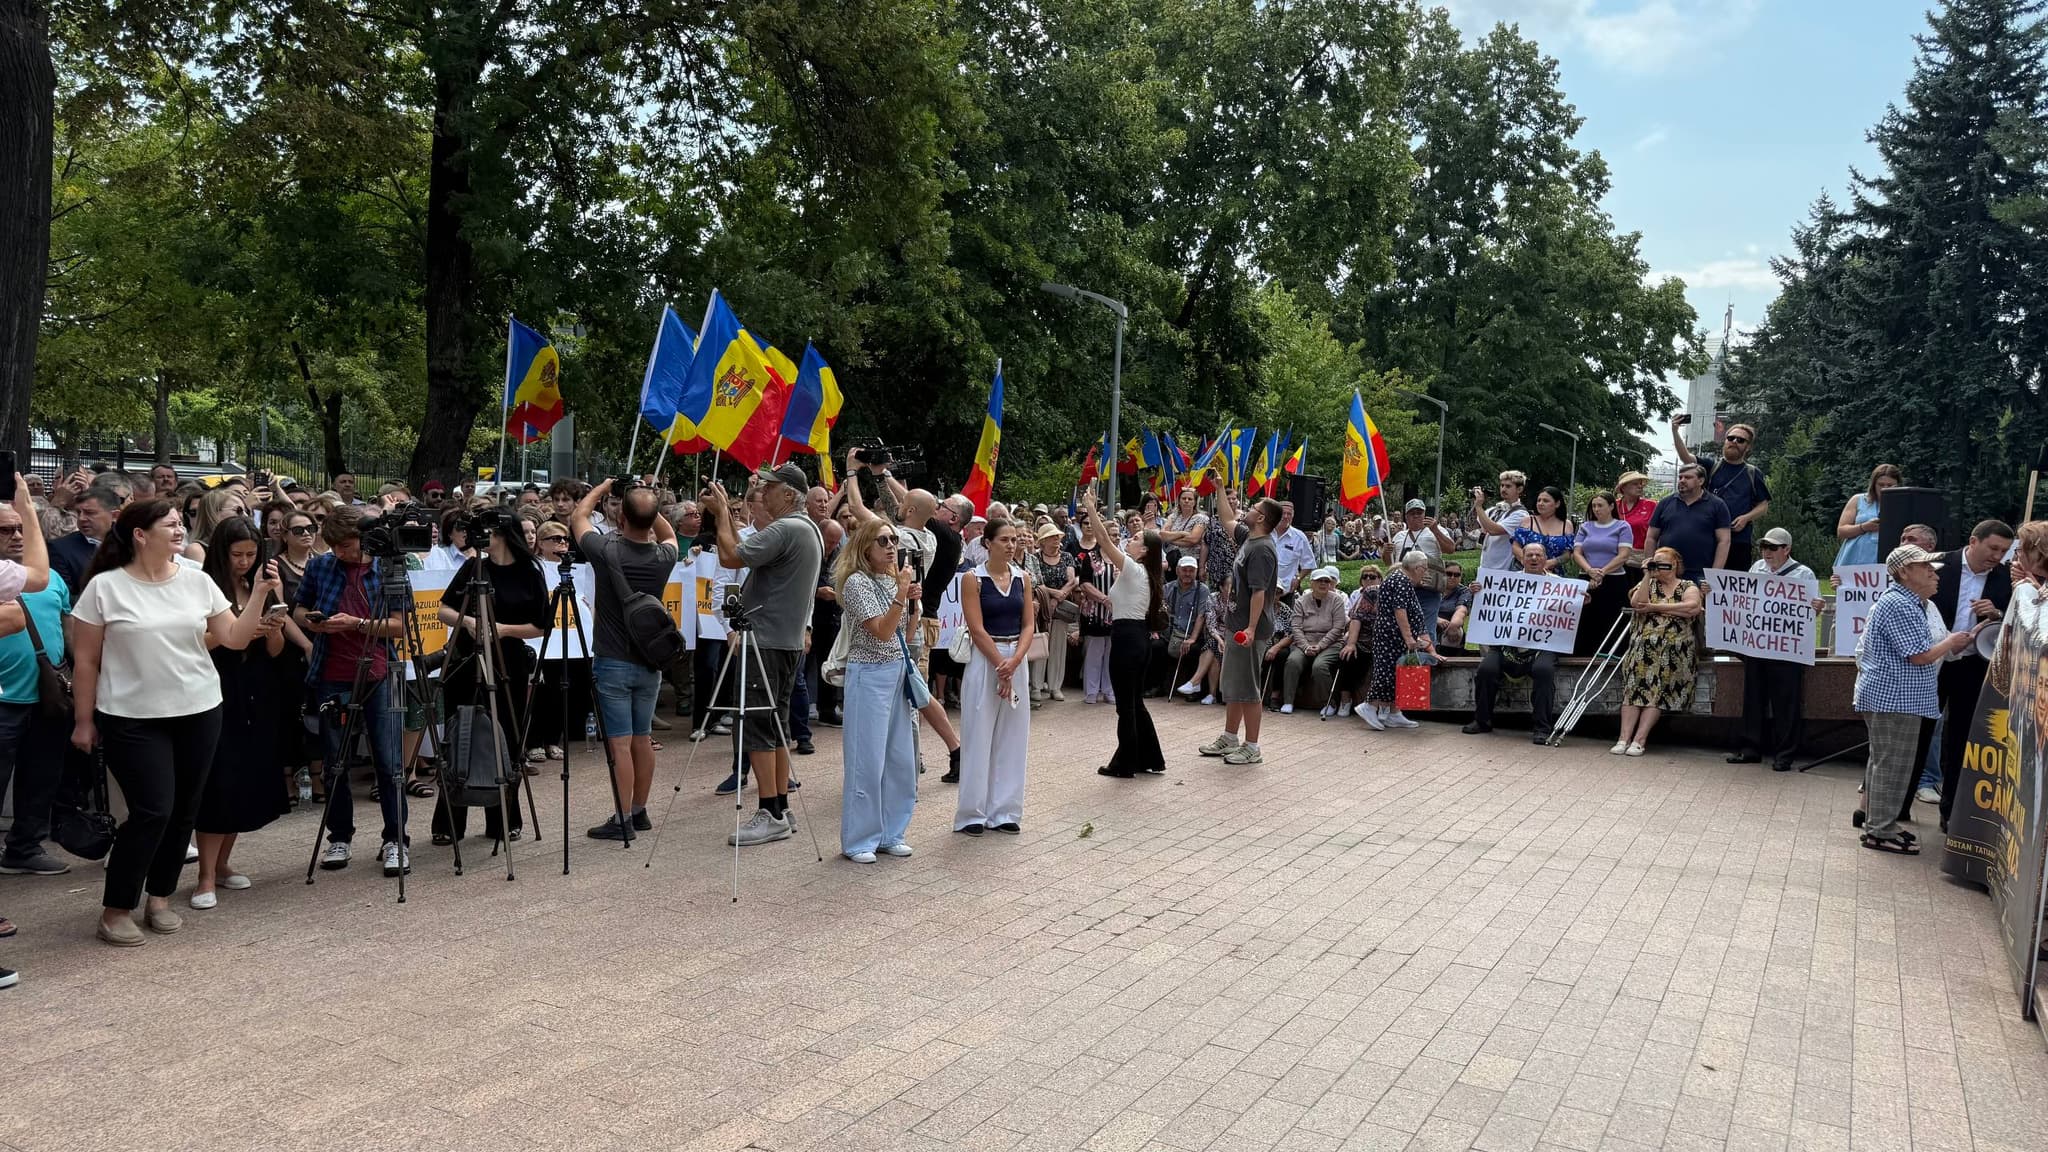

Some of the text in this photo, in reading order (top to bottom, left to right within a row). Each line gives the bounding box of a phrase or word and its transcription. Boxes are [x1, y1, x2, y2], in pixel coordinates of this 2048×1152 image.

[1483, 575, 1579, 598] N-AVEM BANI
[1717, 575, 1808, 602] VREM GAZE
[1854, 571, 1879, 588] NU
[1482, 593, 1575, 617] NICI DE TIZIC,
[1713, 592, 1729, 607] LA
[1763, 599, 1813, 622] CORECT,
[1844, 590, 1866, 602] DIN
[1478, 608, 1576, 631] NU VĂ E RUȘINE
[1722, 609, 1805, 637] NU SCHEME
[1494, 625, 1553, 644] UN PIC?
[1723, 626, 1803, 655] LA PACHET.
